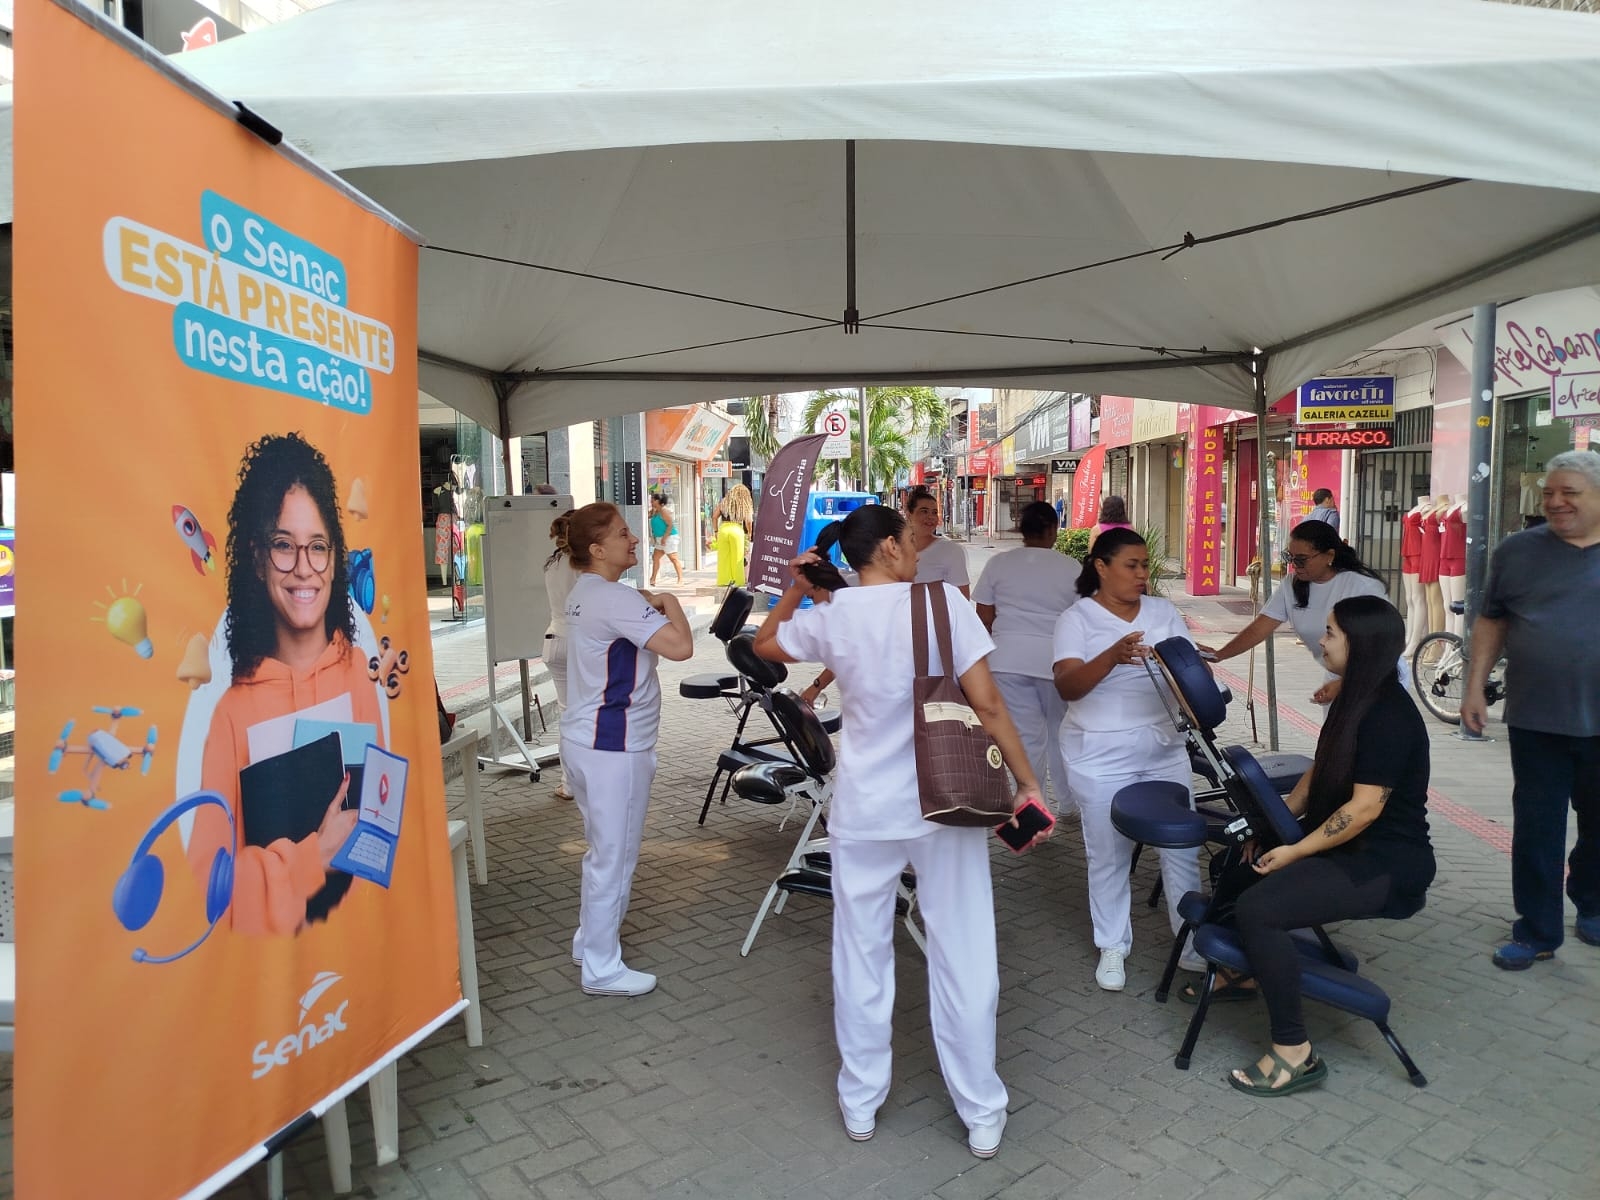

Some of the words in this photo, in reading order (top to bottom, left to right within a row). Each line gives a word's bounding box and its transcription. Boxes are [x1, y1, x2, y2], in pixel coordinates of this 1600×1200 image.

[210, 213, 233, 253] o
[243, 217, 341, 302] Senac
[119, 226, 231, 316] ESTÁ
[238, 273, 391, 368] PRESENTE
[184, 317, 288, 384] nesta
[296, 357, 367, 407] ação!
[1303, 410, 1346, 420] GALERIA
[1348, 409, 1389, 419] CAZELLI
[1557, 379, 1600, 409] Arte
[1029, 410, 1050, 452] VM
[1204, 428, 1217, 475] MODA
[1056, 460, 1076, 468] VM
[785, 458, 807, 530] Camiseteria
[1201, 491, 1216, 587] FEMININA
